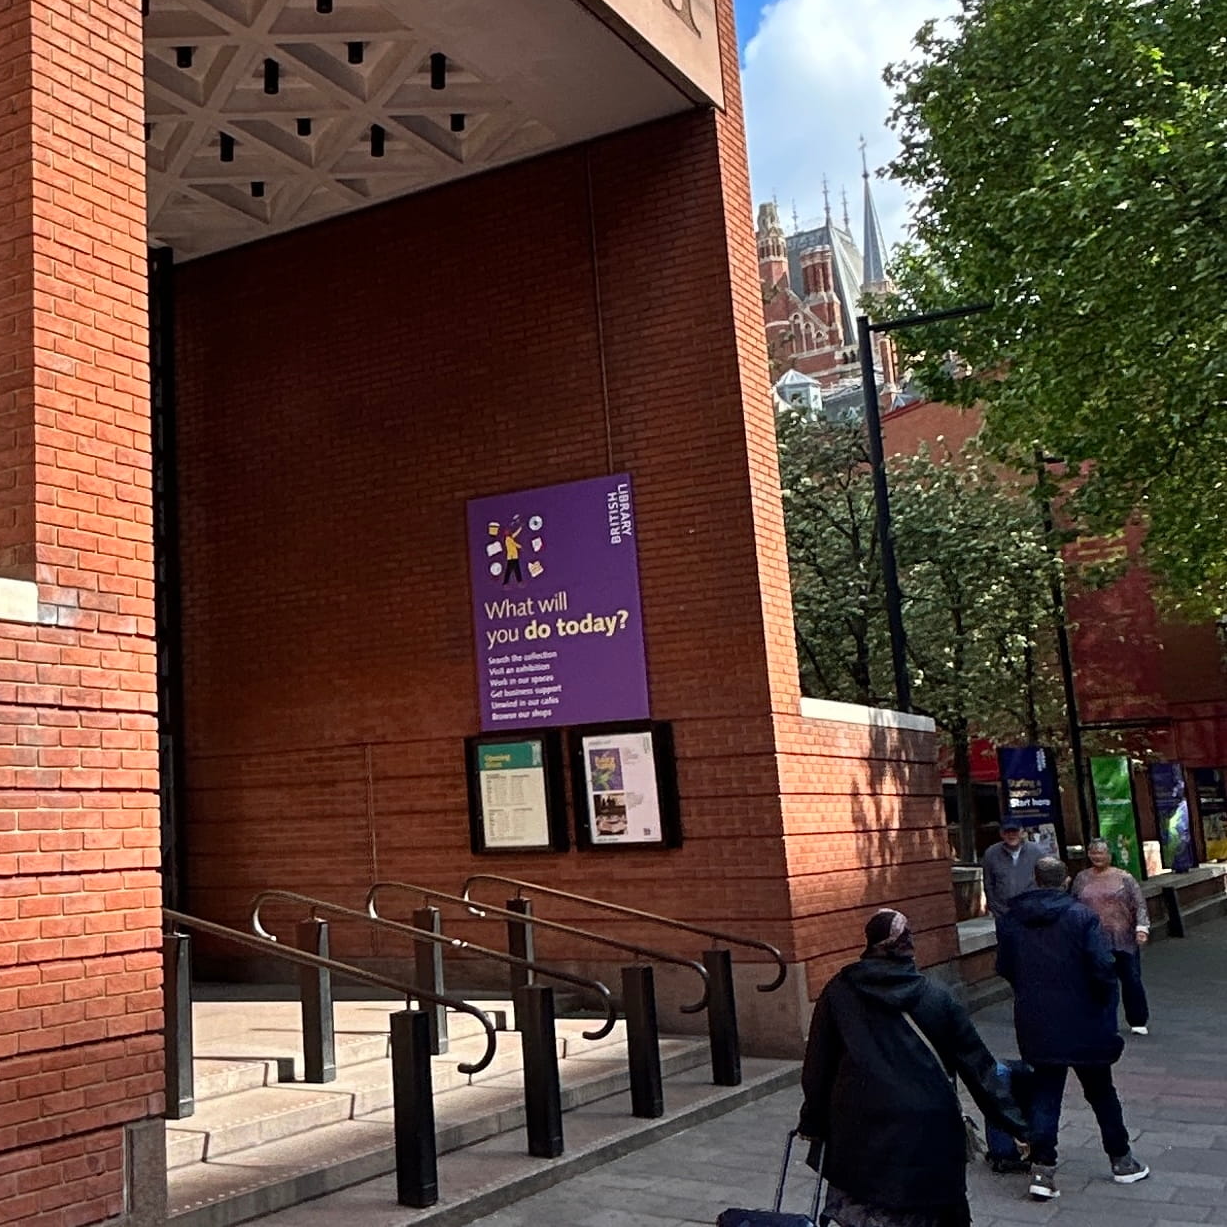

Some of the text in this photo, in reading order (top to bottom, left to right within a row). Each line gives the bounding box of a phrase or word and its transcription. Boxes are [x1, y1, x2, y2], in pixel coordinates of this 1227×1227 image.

[617, 483, 632, 536] LIBRARY
[607, 492, 622, 544] BRITISH
[484, 590, 568, 620] What will
[486, 610, 629, 650] you do today?
[488, 651, 558, 664] Search the collection
[489, 667, 505, 675] Visit
[516, 663, 550, 673] exhibition
[489, 677, 508, 687] Work
[531, 674, 554, 685] spaces
[490, 684, 562, 698] Get business support
[491, 699, 518, 709] Unwind
[492, 712, 517, 721] Browse
[531, 708, 552, 719] shops
